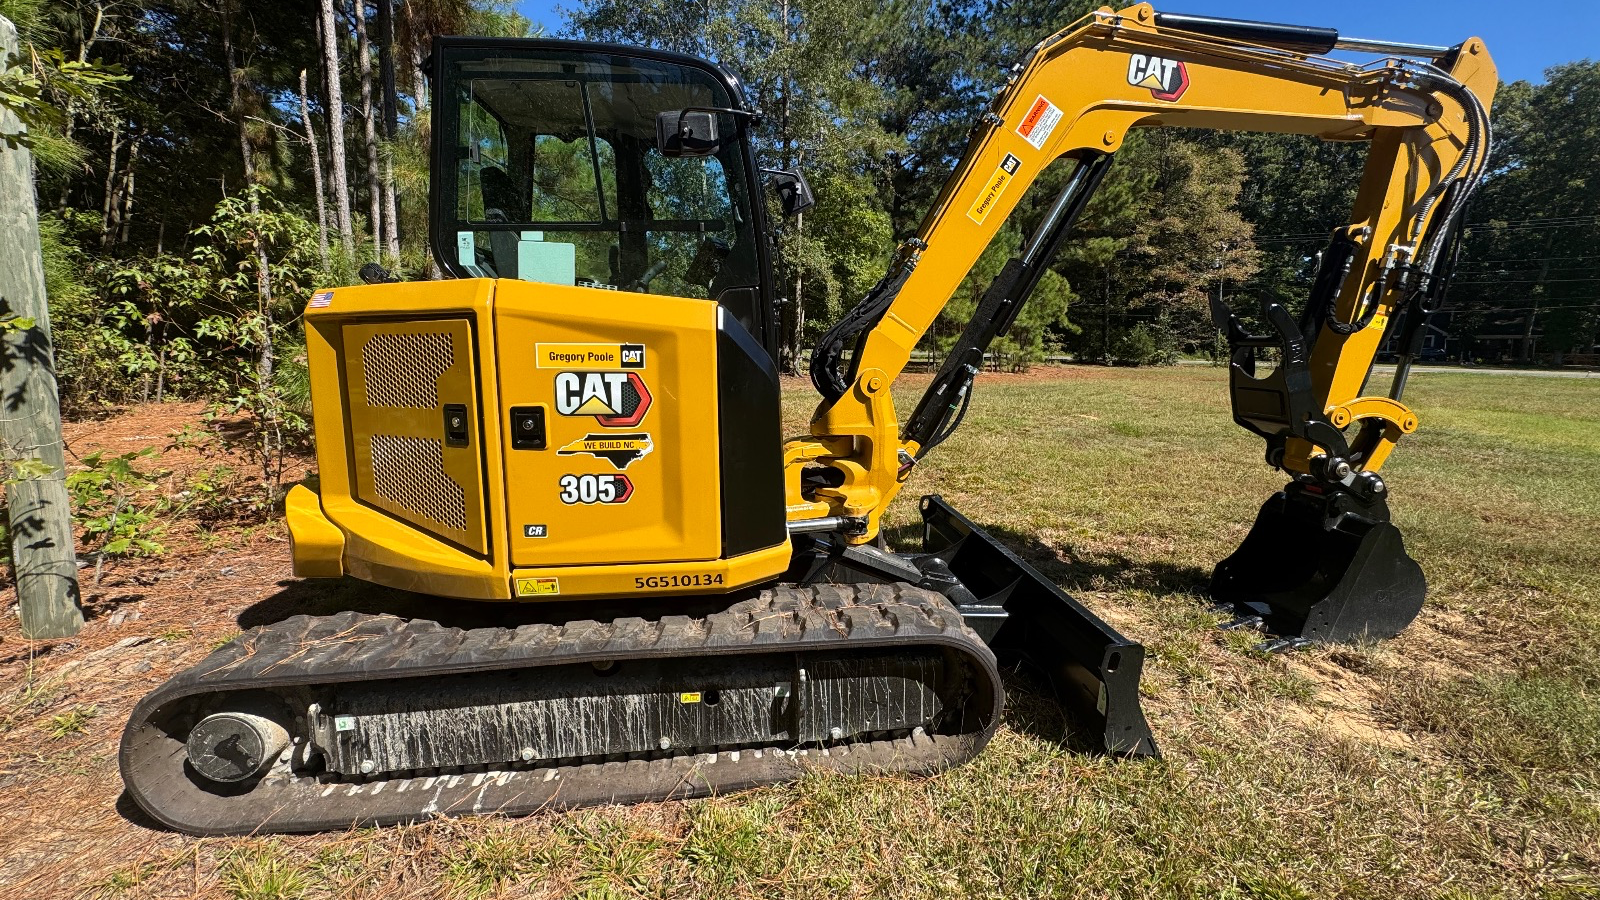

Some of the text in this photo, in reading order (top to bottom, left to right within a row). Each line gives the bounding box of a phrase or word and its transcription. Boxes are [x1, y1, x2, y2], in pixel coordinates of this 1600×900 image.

[1128, 54, 1178, 92] CAT
[1029, 100, 1046, 124] WARNING
[1003, 156, 1018, 173] CAT
[976, 175, 1006, 215] Gregory Poole
[549, 351, 614, 363] Gregory Poole
[622, 350, 642, 362] CAT
[555, 372, 628, 415] CAT
[584, 441, 635, 450] WE BUILD NC
[560, 474, 616, 503] 305
[528, 526, 543, 536] CR
[634, 573, 724, 589] 5G510134
